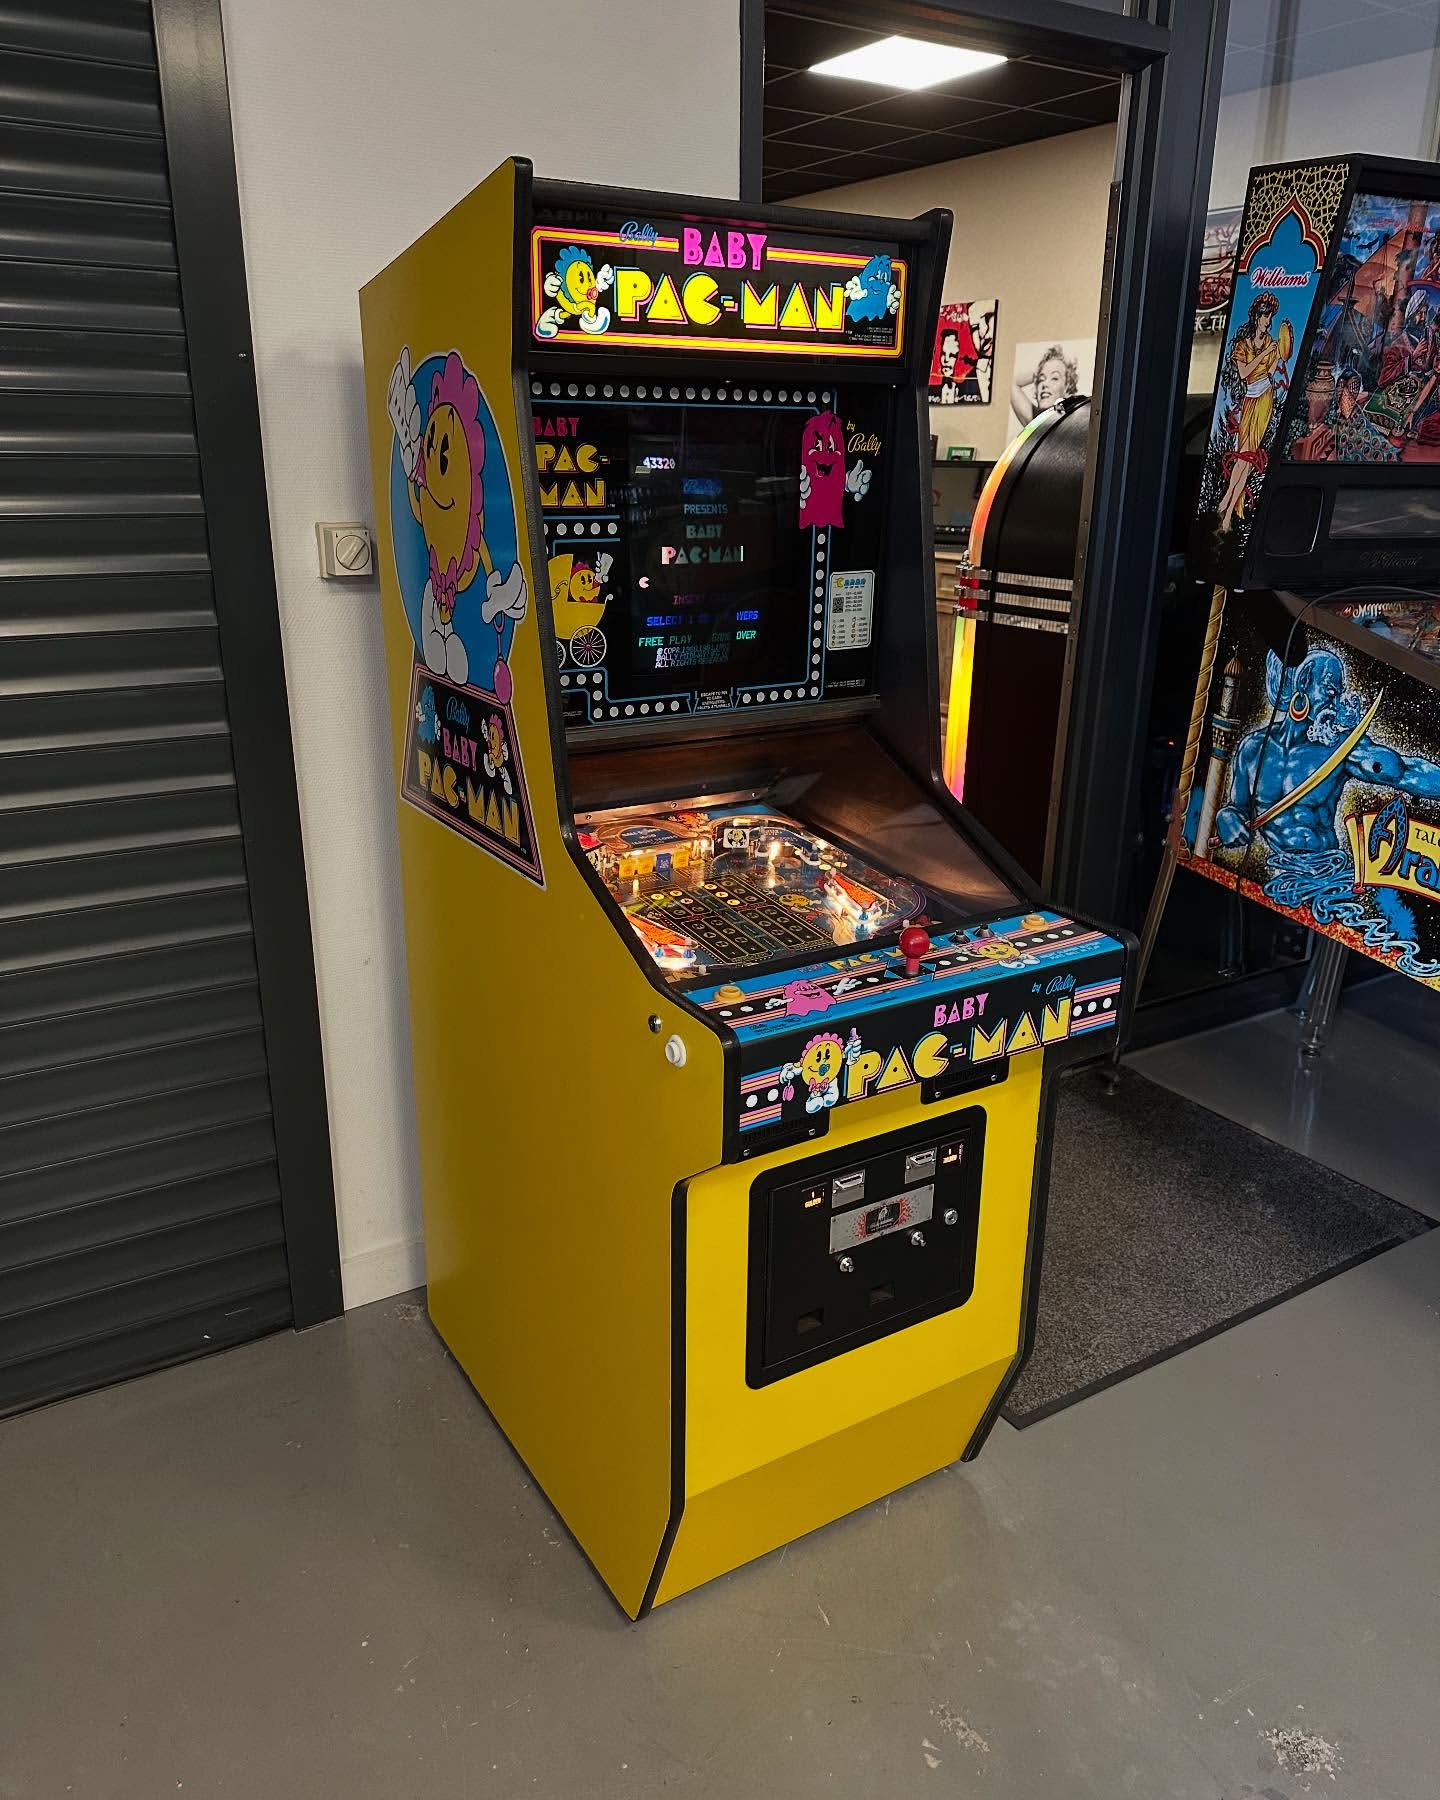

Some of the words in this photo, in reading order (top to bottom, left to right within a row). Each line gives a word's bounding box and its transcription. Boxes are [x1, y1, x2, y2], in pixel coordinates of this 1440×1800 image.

[619, 220, 659, 246] Bally
[683, 227, 768, 271] BABY
[1250, 265, 1310, 289] Williams
[613, 266, 847, 334] PAC-MAN
[532, 416, 581, 437] BABY
[846, 420, 856, 433] by
[847, 433, 882, 456] Bally
[643, 456, 676, 470] 43320
[539, 477, 606, 510] MAN
[683, 503, 729, 514] PRESENTS
[686, 523, 722, 540] BABY
[639, 636, 665, 648] FREE
[669, 634, 693, 645] PLAY
[736, 630, 757, 641] OVER
[446, 696, 471, 736] Bally
[442, 726, 479, 773] BABY
[417, 748, 521, 848] PAC-MAN
[1368, 793, 1440, 893] Ara
[1031, 982, 1042, 993] by
[1045, 974, 1077, 996] Bally
[933, 992, 989, 1028] BABY
[843, 996, 1072, 1102] PAC-MAN
